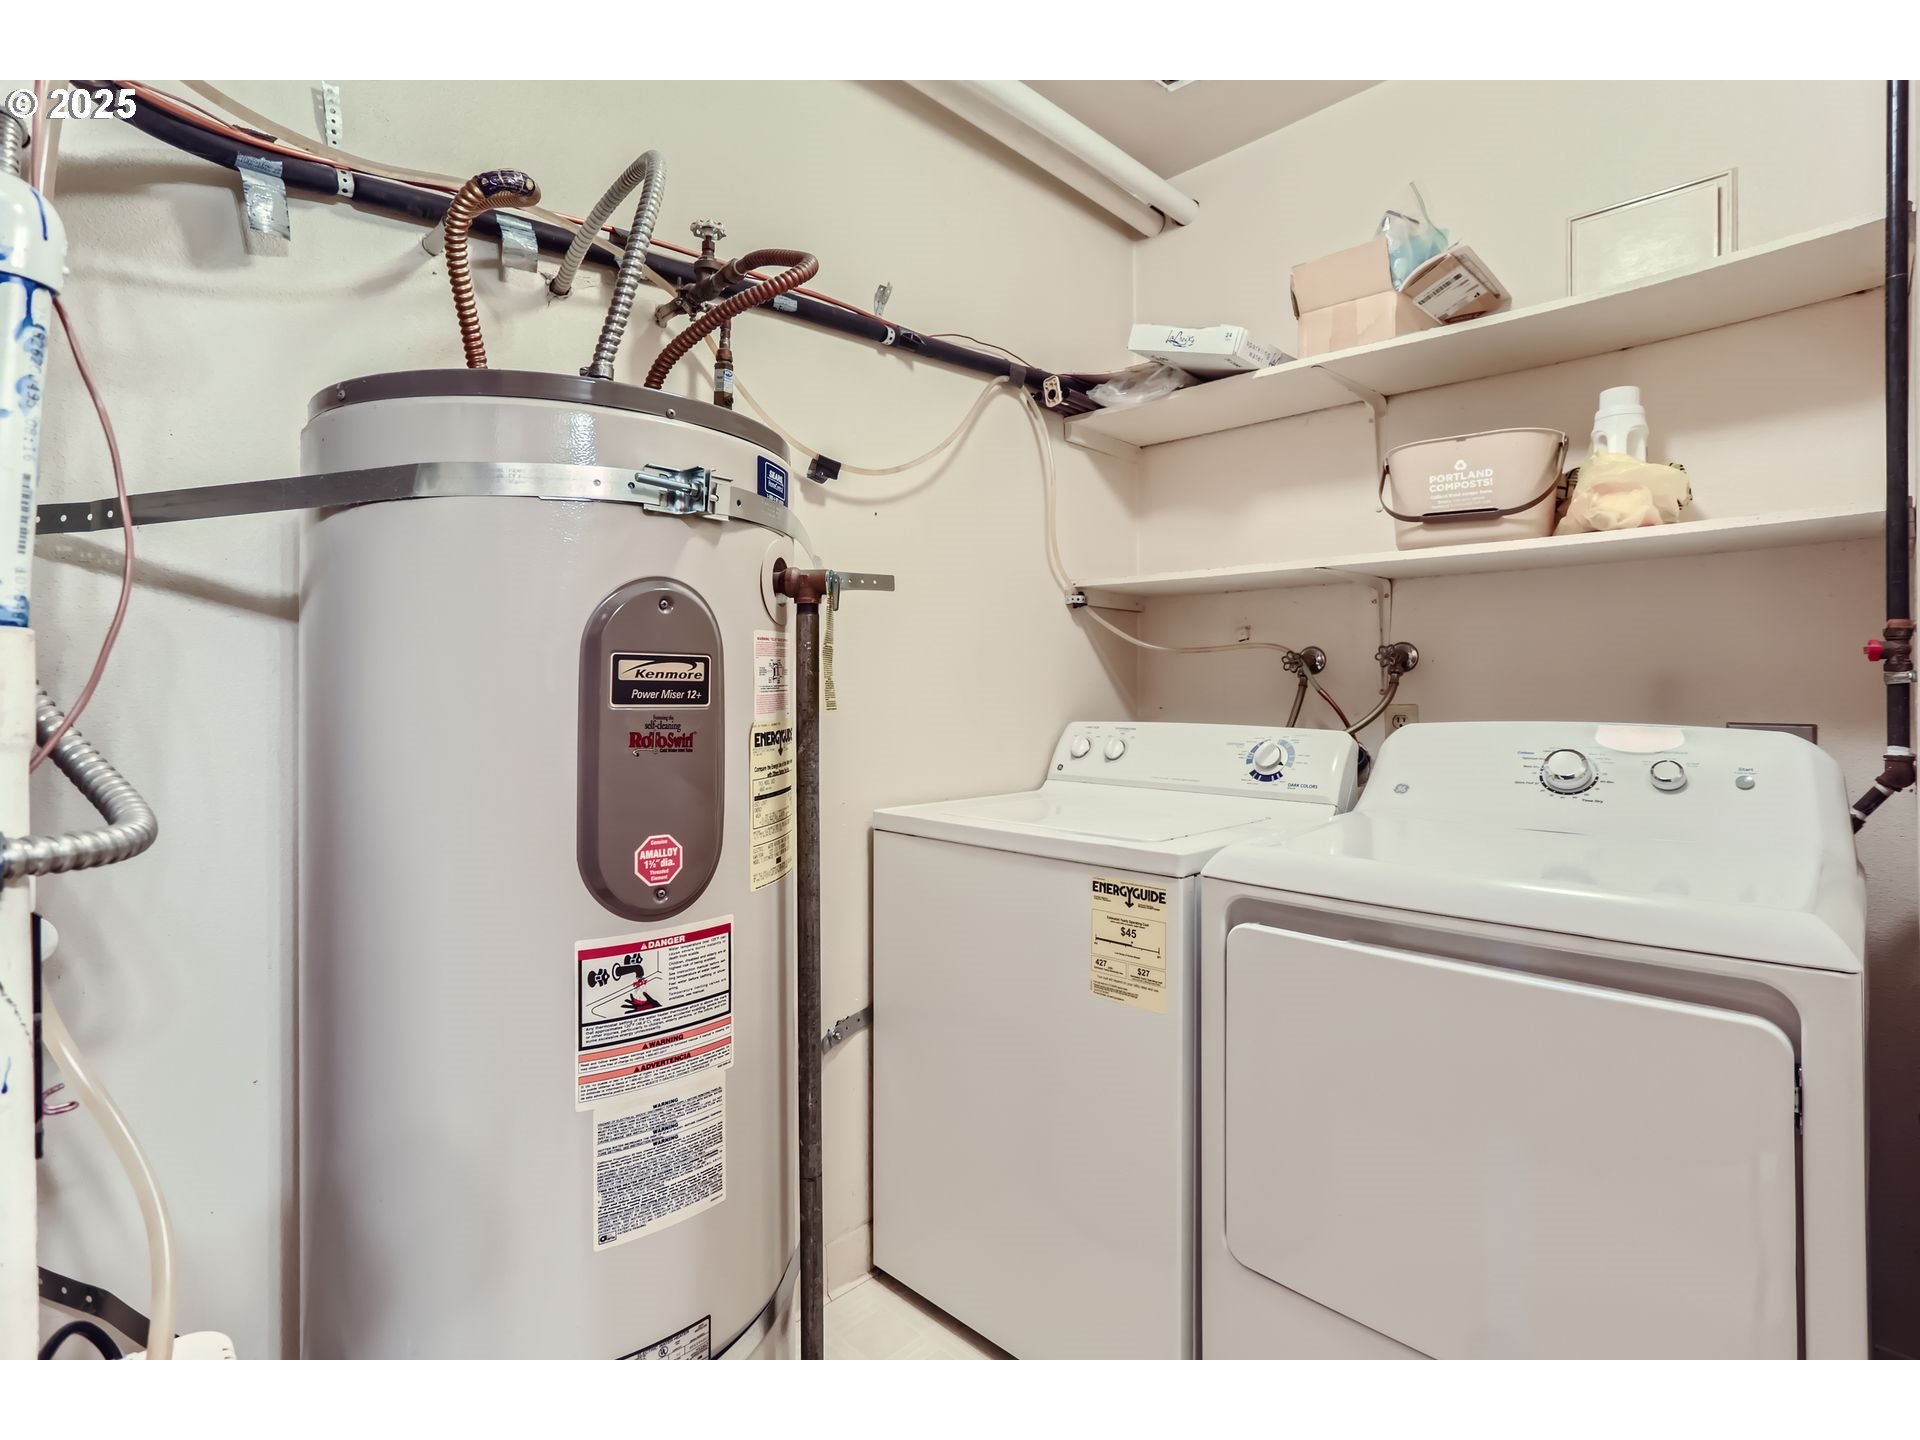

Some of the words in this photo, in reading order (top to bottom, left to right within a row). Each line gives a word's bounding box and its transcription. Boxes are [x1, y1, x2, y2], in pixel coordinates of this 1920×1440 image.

[1429, 468, 1494, 484] PORTLAND
[1429, 478, 1494, 493] COMPOSTS!
[635, 669, 703, 680] Kenmore
[631, 689, 660, 699] Power
[661, 689, 685, 699] Miser
[687, 690, 702, 699] 12+
[645, 720, 682, 732] self-cleaning
[640, 847, 678, 860] AMALLOY
[660, 858, 675, 867] dia.
[1092, 880, 1167, 905] ENERGYGUIDE
[1121, 926, 1137, 939] $45
[648, 935, 686, 949] DANGER
[1096, 959, 1107, 967] 427
[1137, 968, 1150, 978] $27
[649, 1034, 684, 1049] WARNING
[641, 1053, 692, 1072] ADVERTENCIA
[653, 1098, 679, 1109] WARNING
[653, 1122, 679, 1135] WARNING
[653, 1134, 679, 1146] WARNING
